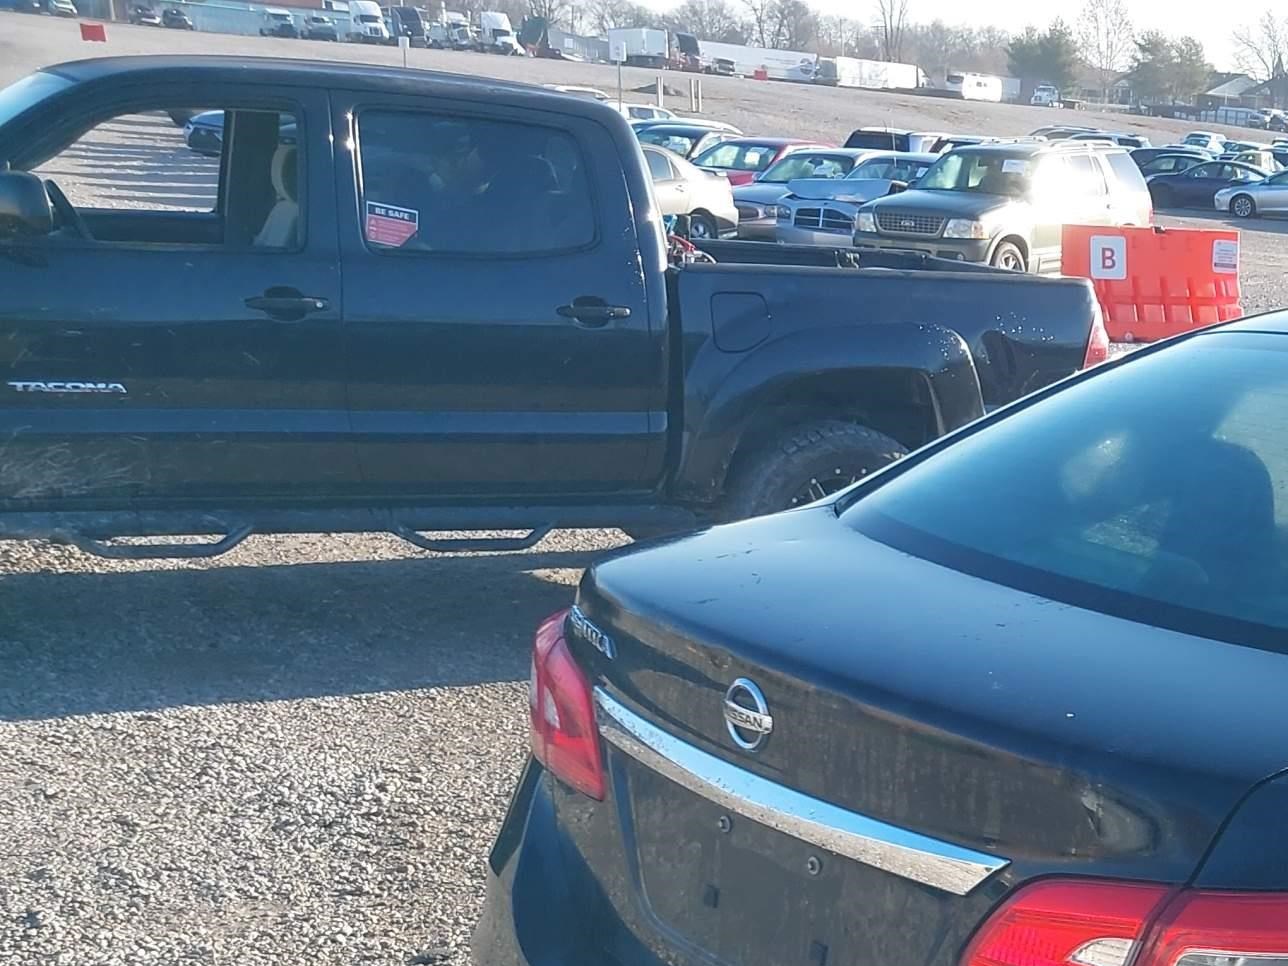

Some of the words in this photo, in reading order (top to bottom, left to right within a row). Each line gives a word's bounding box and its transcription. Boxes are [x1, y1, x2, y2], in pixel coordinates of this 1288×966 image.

[375, 207, 386, 216] BE
[388, 210, 409, 219] SAFE
[1101, 247, 1116, 269] B
[7, 381, 128, 393] TACOMA
